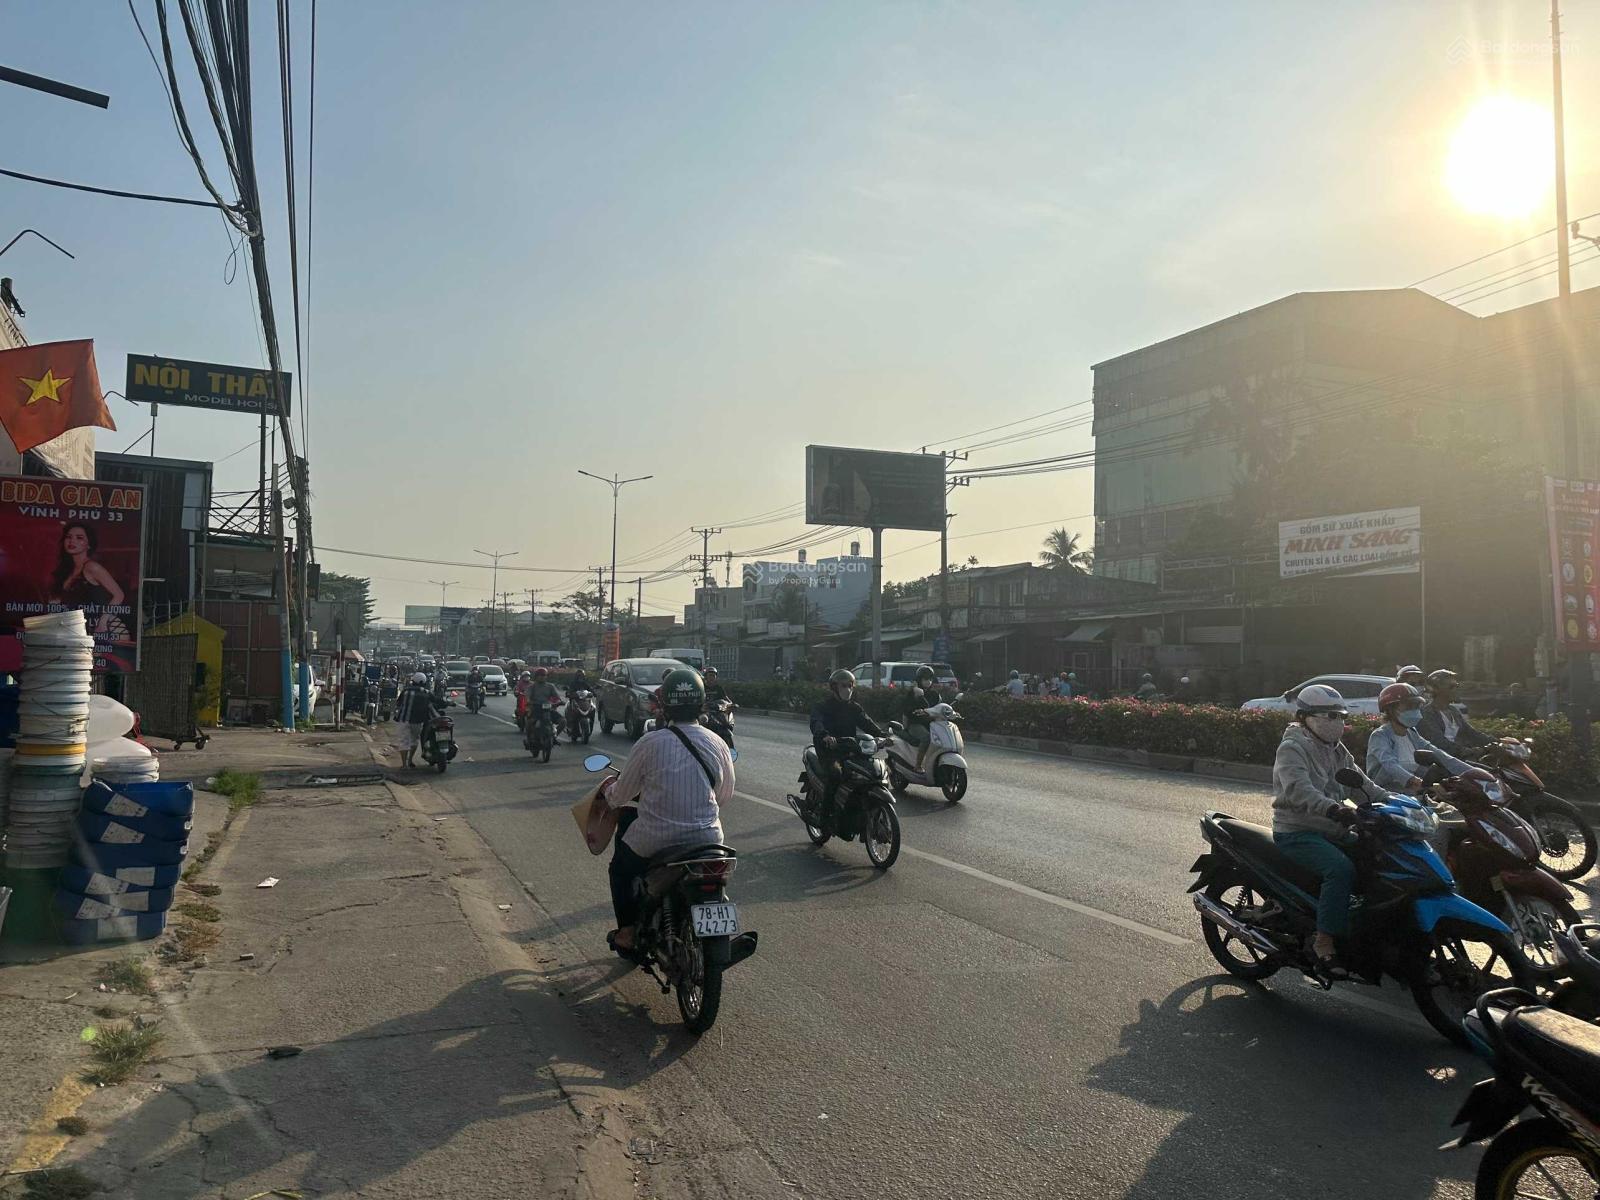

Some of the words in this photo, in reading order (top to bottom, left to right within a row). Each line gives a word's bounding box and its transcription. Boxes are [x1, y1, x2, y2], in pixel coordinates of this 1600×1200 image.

[134, 361, 190, 395] NỘI
[184, 393, 233, 406] MODEL
[1, 481, 55, 504] BIDA
[61, 485, 103, 507] GIA
[108, 489, 141, 510] AN
[108, 512, 123, 521] 33
[1284, 535, 1345, 554] MINH
[1349, 528, 1411, 549] SANG
[699, 906, 729, 920] 78-H1
[697, 920, 737, 934] 242.73
